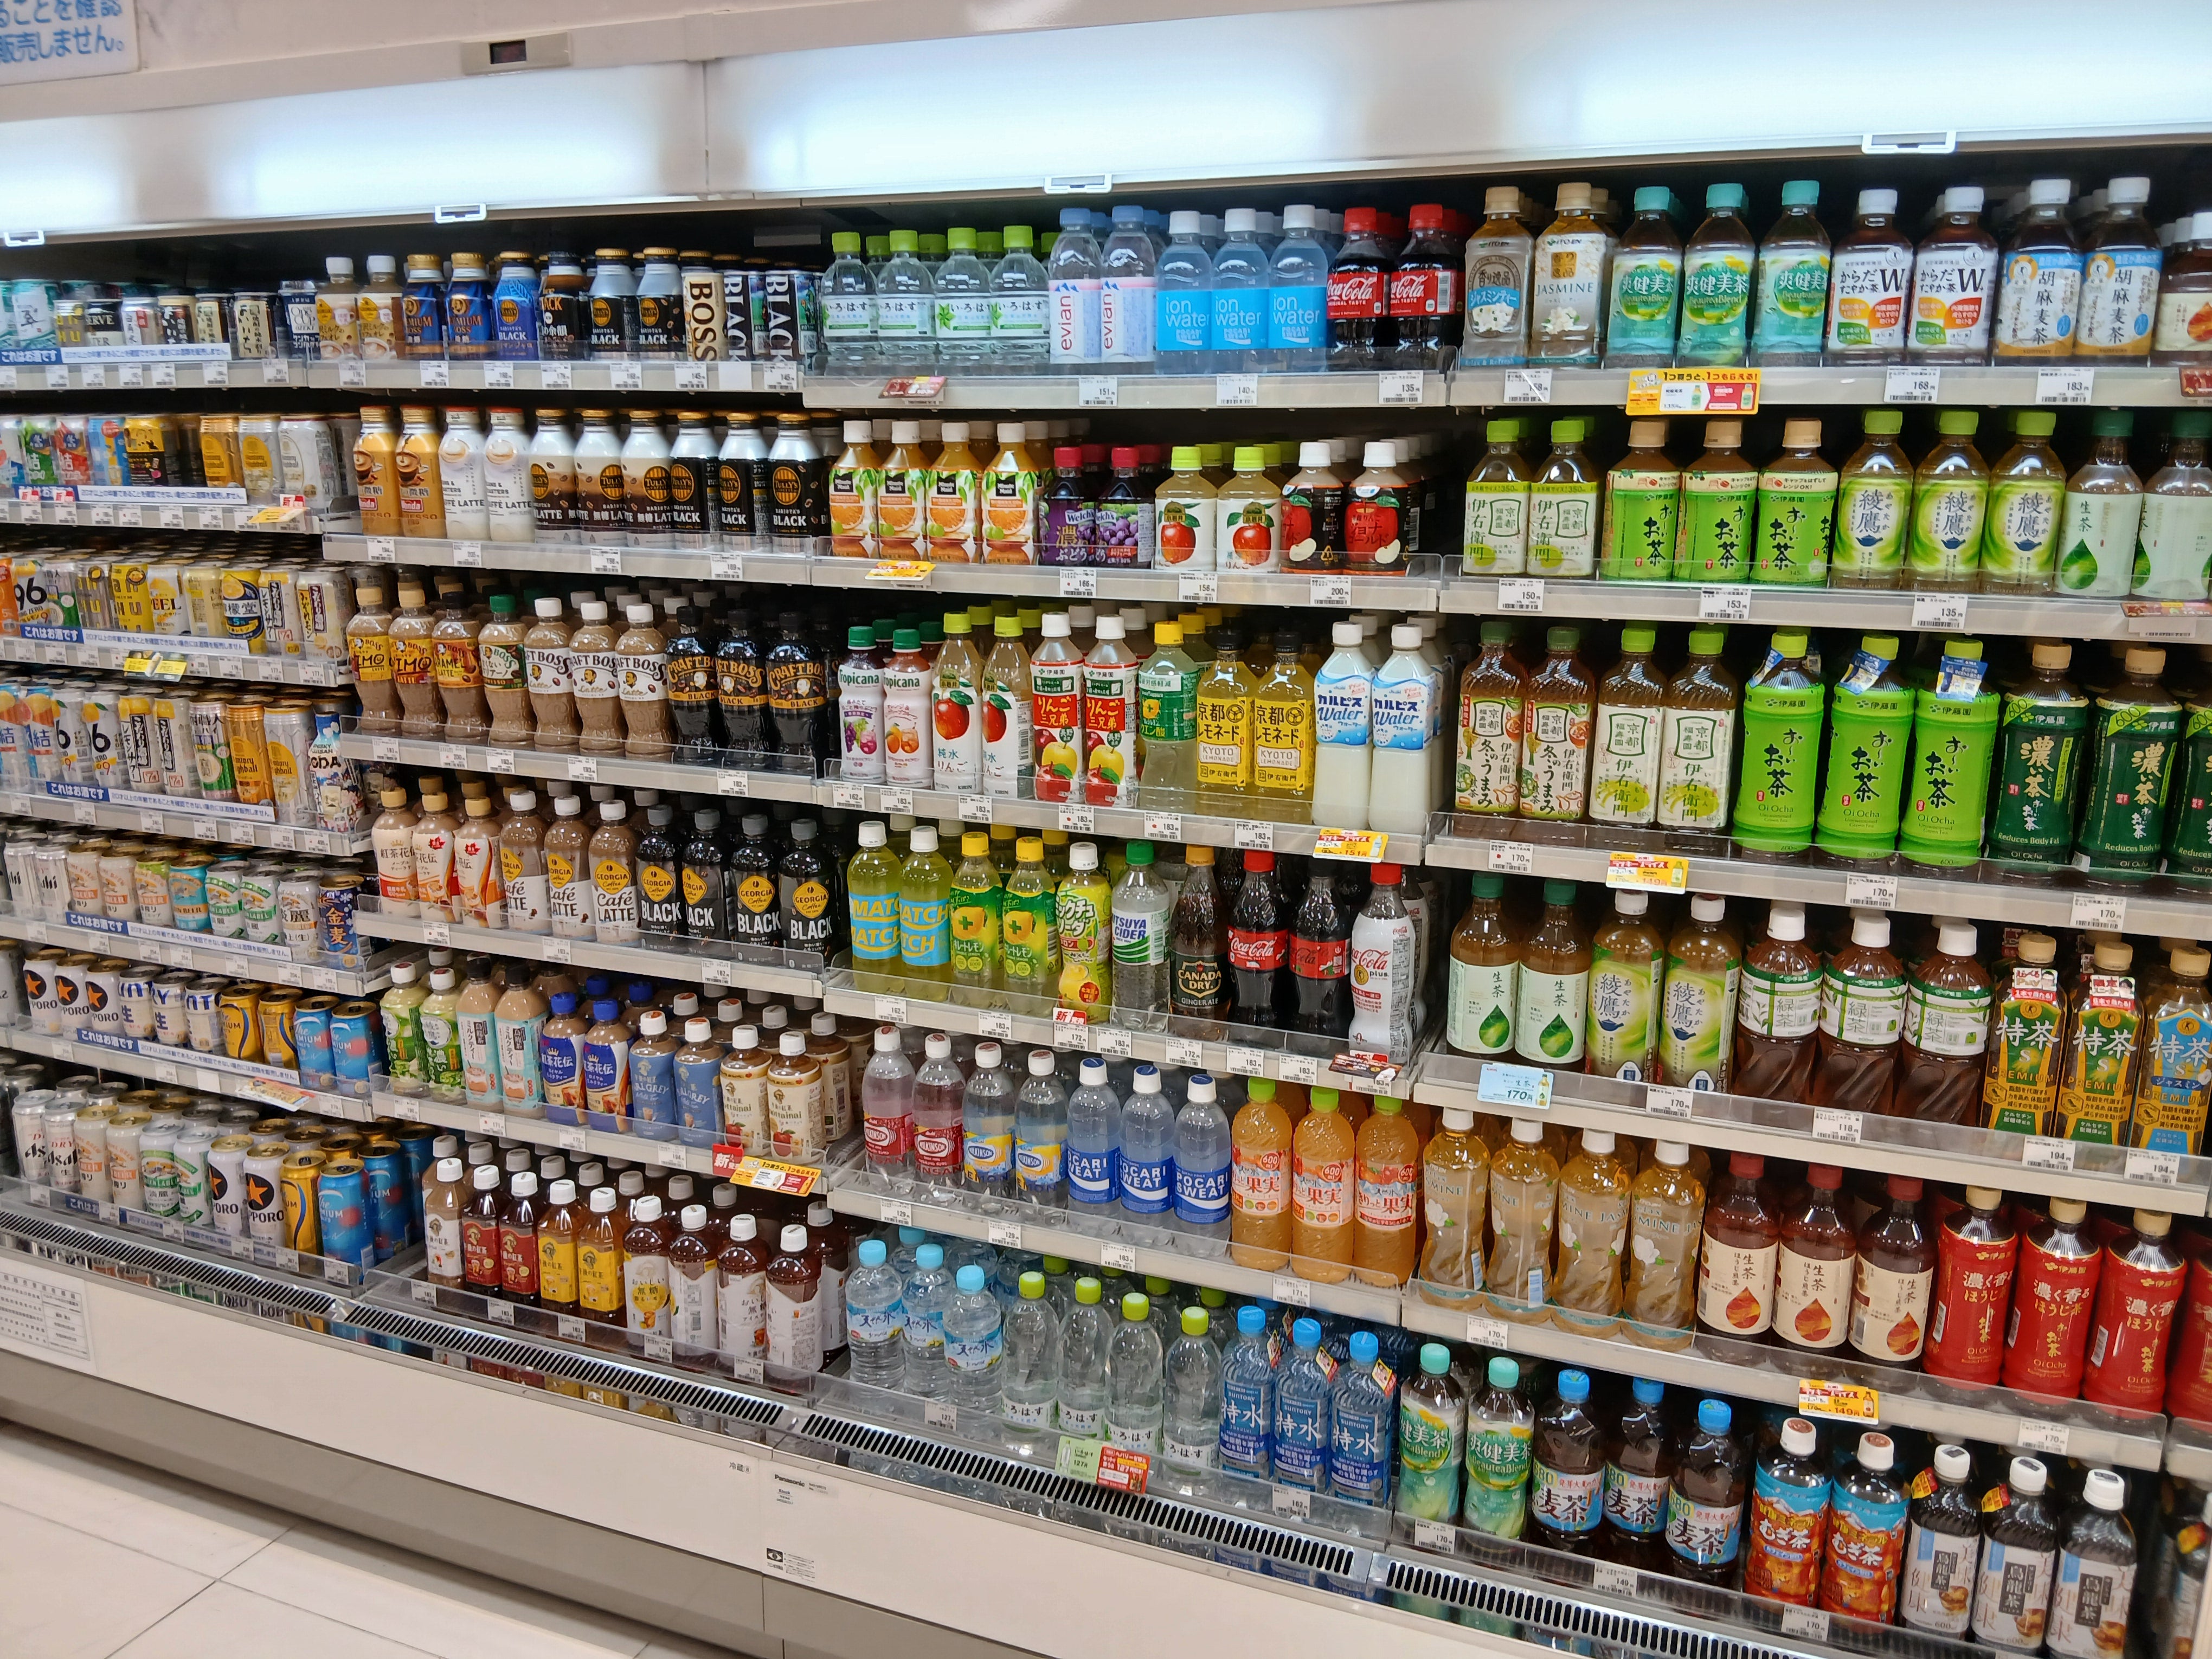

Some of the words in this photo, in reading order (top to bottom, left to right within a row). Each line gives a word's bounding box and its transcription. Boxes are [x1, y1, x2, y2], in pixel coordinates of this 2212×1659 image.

[1685, 272, 1748, 296] 爽健美茶
[1839, 268, 1876, 284] からだ
[1879, 268, 1906, 292] W
[1958, 268, 1984, 292] W
[1535, 281, 1594, 297] JASMINE
[1166, 296, 1192, 313] ion
[1216, 295, 1238, 312] ion
[1273, 293, 1297, 310] ion
[2032, 270, 2056, 346] 胡麻麦茶
[2108, 268, 2133, 345] 胡麻麦茶
[689, 281, 717, 361] BOSS
[1060, 295, 1072, 351] evian
[1103, 293, 1114, 350] evian
[1166, 310, 1211, 327] water
[1216, 310, 1261, 325] water
[1273, 308, 1320, 324] water
[498, 331, 527, 340] BLACK
[591, 335, 620, 345] BLACK
[639, 335, 667, 345] BLACK
[458, 499, 485, 507] LATTE
[505, 500, 532, 509] LATTE
[773, 515, 807, 526] BLACK
[1066, 510, 1095, 523] Welch's
[1855, 489, 1885, 536] 綾鷹
[1941, 491, 1968, 537] 綾鷹
[2015, 491, 2044, 537] 綾鷹
[2078, 500, 2092, 532] 生茶
[1056, 548, 1087, 562] ぶどう
[24, 626, 79, 641] これはお酒です
[667, 658, 700, 682] CRAFT
[839, 670, 879, 687] Tropicana
[687, 692, 715, 700] BLACK
[1037, 697, 1071, 712] りんご
[1317, 693, 1364, 707] カルピス
[1374, 698, 1419, 712] カルピス
[1086, 700, 1121, 716] りんご
[1198, 704, 1225, 722] 京都
[1256, 705, 1285, 723] 京都
[1316, 706, 1364, 722] Water
[2114, 706, 2142, 727] 600
[1040, 714, 1070, 727] 三兄弟
[1088, 716, 1118, 730] 三兄弟
[1373, 711, 1419, 725] Water
[2034, 714, 2066, 725] 伊藤園
[2147, 721, 2175, 731] 伊藤園
[1198, 724, 1240, 743] レモネード
[1256, 726, 1300, 747] レモネード
[1201, 746, 1234, 756] KYOTO
[1203, 754, 1234, 763] LEMONADE
[1260, 749, 1294, 760] KYOTO
[1260, 757, 1293, 767] LEMONADE
[1764, 743, 1793, 798] お茶
[2020, 736, 2055, 799] 濃い茶
[1477, 738, 1499, 810] 冬のうまみ
[2131, 742, 2165, 806] 濃い茶
[50, 782, 104, 800] これはお酒です
[1612, 757, 1634, 818] 伊右衛門
[1681, 762, 1703, 822] 伊右衛門
[1758, 804, 1769, 813] Oi
[1770, 804, 1794, 813] Ocha
[1998, 832, 2028, 844] Reduces
[643, 879, 672, 887] GEORGIA
[597, 892, 633, 907] Café
[740, 889, 773, 897] GEORGIA
[794, 895, 829, 903] GEORGIA
[598, 907, 634, 922] LATTE
[641, 902, 680, 921] BLACK
[70, 914, 124, 933] これはお酒です
[326, 906, 348, 945] 金麦
[737, 911, 781, 934] BLACK
[790, 918, 832, 940] BLACK
[1114, 927, 1147, 940] CIDER
[1230, 937, 1274, 958] Coca-Cola
[1178, 969, 1222, 981] CANADA
[1369, 969, 1388, 978] plus
[1490, 971, 1506, 999] 生茶
[1553, 979, 1568, 1007] 生茶
[1181, 997, 1204, 1006] GINGER
[1598, 973, 1622, 1019] 綾鷹
[1672, 981, 1696, 1028] 綾鷹
[1776, 998, 1795, 1027] 緑茶
[1847, 1001, 1867, 1034] 緑茶
[1924, 1010, 1944, 1044] 緑茶
[1995, 1015, 2060, 1048] 特茶
[80, 1030, 135, 1050] これはお酒です
[2072, 1025, 2137, 1059] 特茶
[2149, 1034, 2212, 1066] 特茶
[1992, 1066, 2054, 1083] PREMIUM
[2068, 1076, 2131, 1092] PREMIUM
[1506, 1089, 1533, 1102] 170円
[2144, 1088, 2208, 1104] PREMIUM
[1176, 1171, 1229, 1187] POCARI
[1246, 1176, 1281, 1194] 果実
[1176, 1184, 1225, 1199] SWEAT
[1307, 1188, 1342, 1205] 果実
[1741, 1253, 1756, 1279] 生茶
[1812, 1264, 1827, 1293] 生茶
[2035, 1298, 2083, 1317] ほうじ茶
[1221, 1401, 1264, 1429] 特水
[1276, 1414, 1319, 1442] 特水
[1333, 1426, 1378, 1455] 特水
[1470, 1432, 1532, 1464] 爽健美茶
[775, 1474, 805, 1487] Panasonic
[1539, 1488, 1588, 1524] 麦茶
[1606, 1490, 1658, 1526] 麦茶
[1674, 1517, 1726, 1556] 麦茶
[1758, 1517, 1812, 1551] むぎ茶
[1832, 1535, 1886, 1567] むぎ茶
[2005, 1566, 2025, 1612] 烏龍茶
